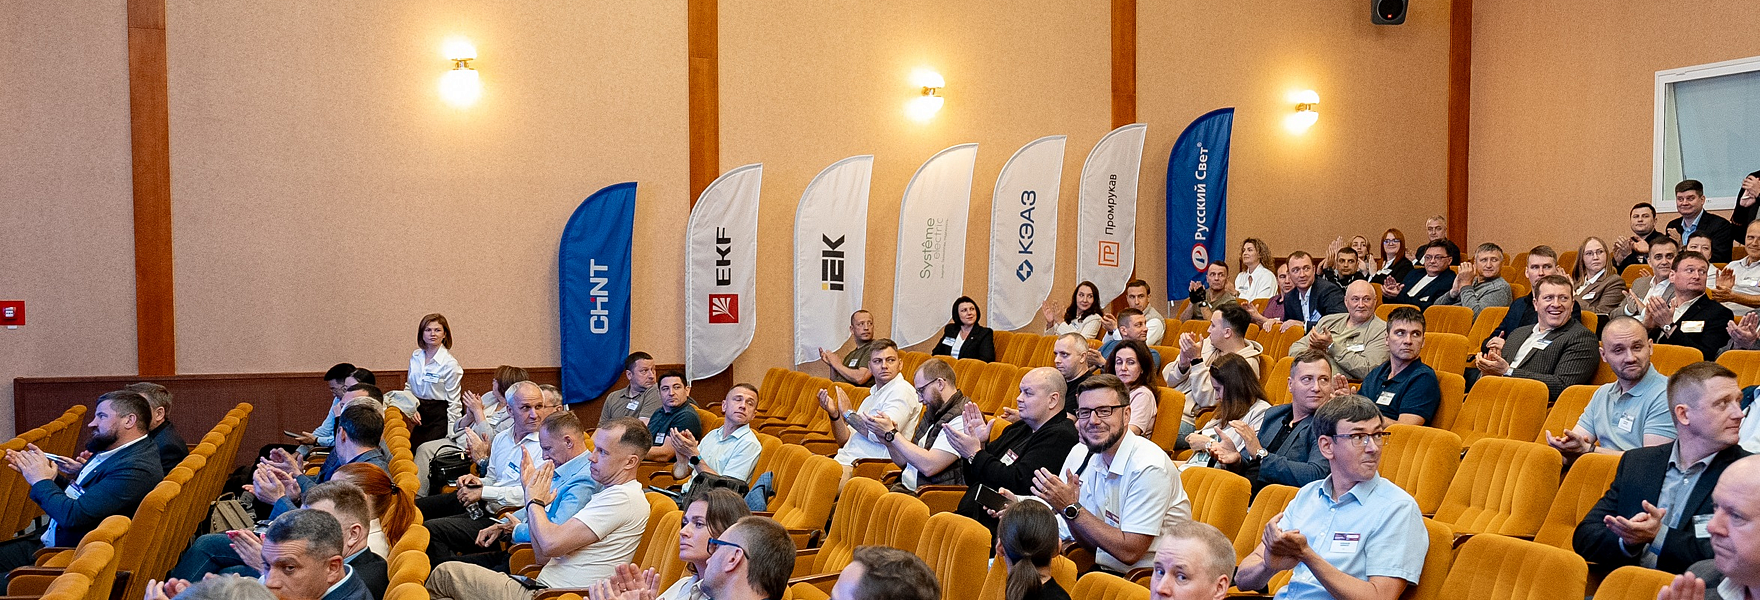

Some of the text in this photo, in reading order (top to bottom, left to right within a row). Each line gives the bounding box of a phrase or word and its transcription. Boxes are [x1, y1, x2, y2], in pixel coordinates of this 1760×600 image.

[1018, 190, 1037, 255] КЭАЗ
[1105, 174, 1118, 236] Промрукав
[1194, 183, 1209, 241] Русский
[716, 226, 732, 287] EKF
[919, 217, 936, 279] Systême
[931, 217, 944, 260] electric
